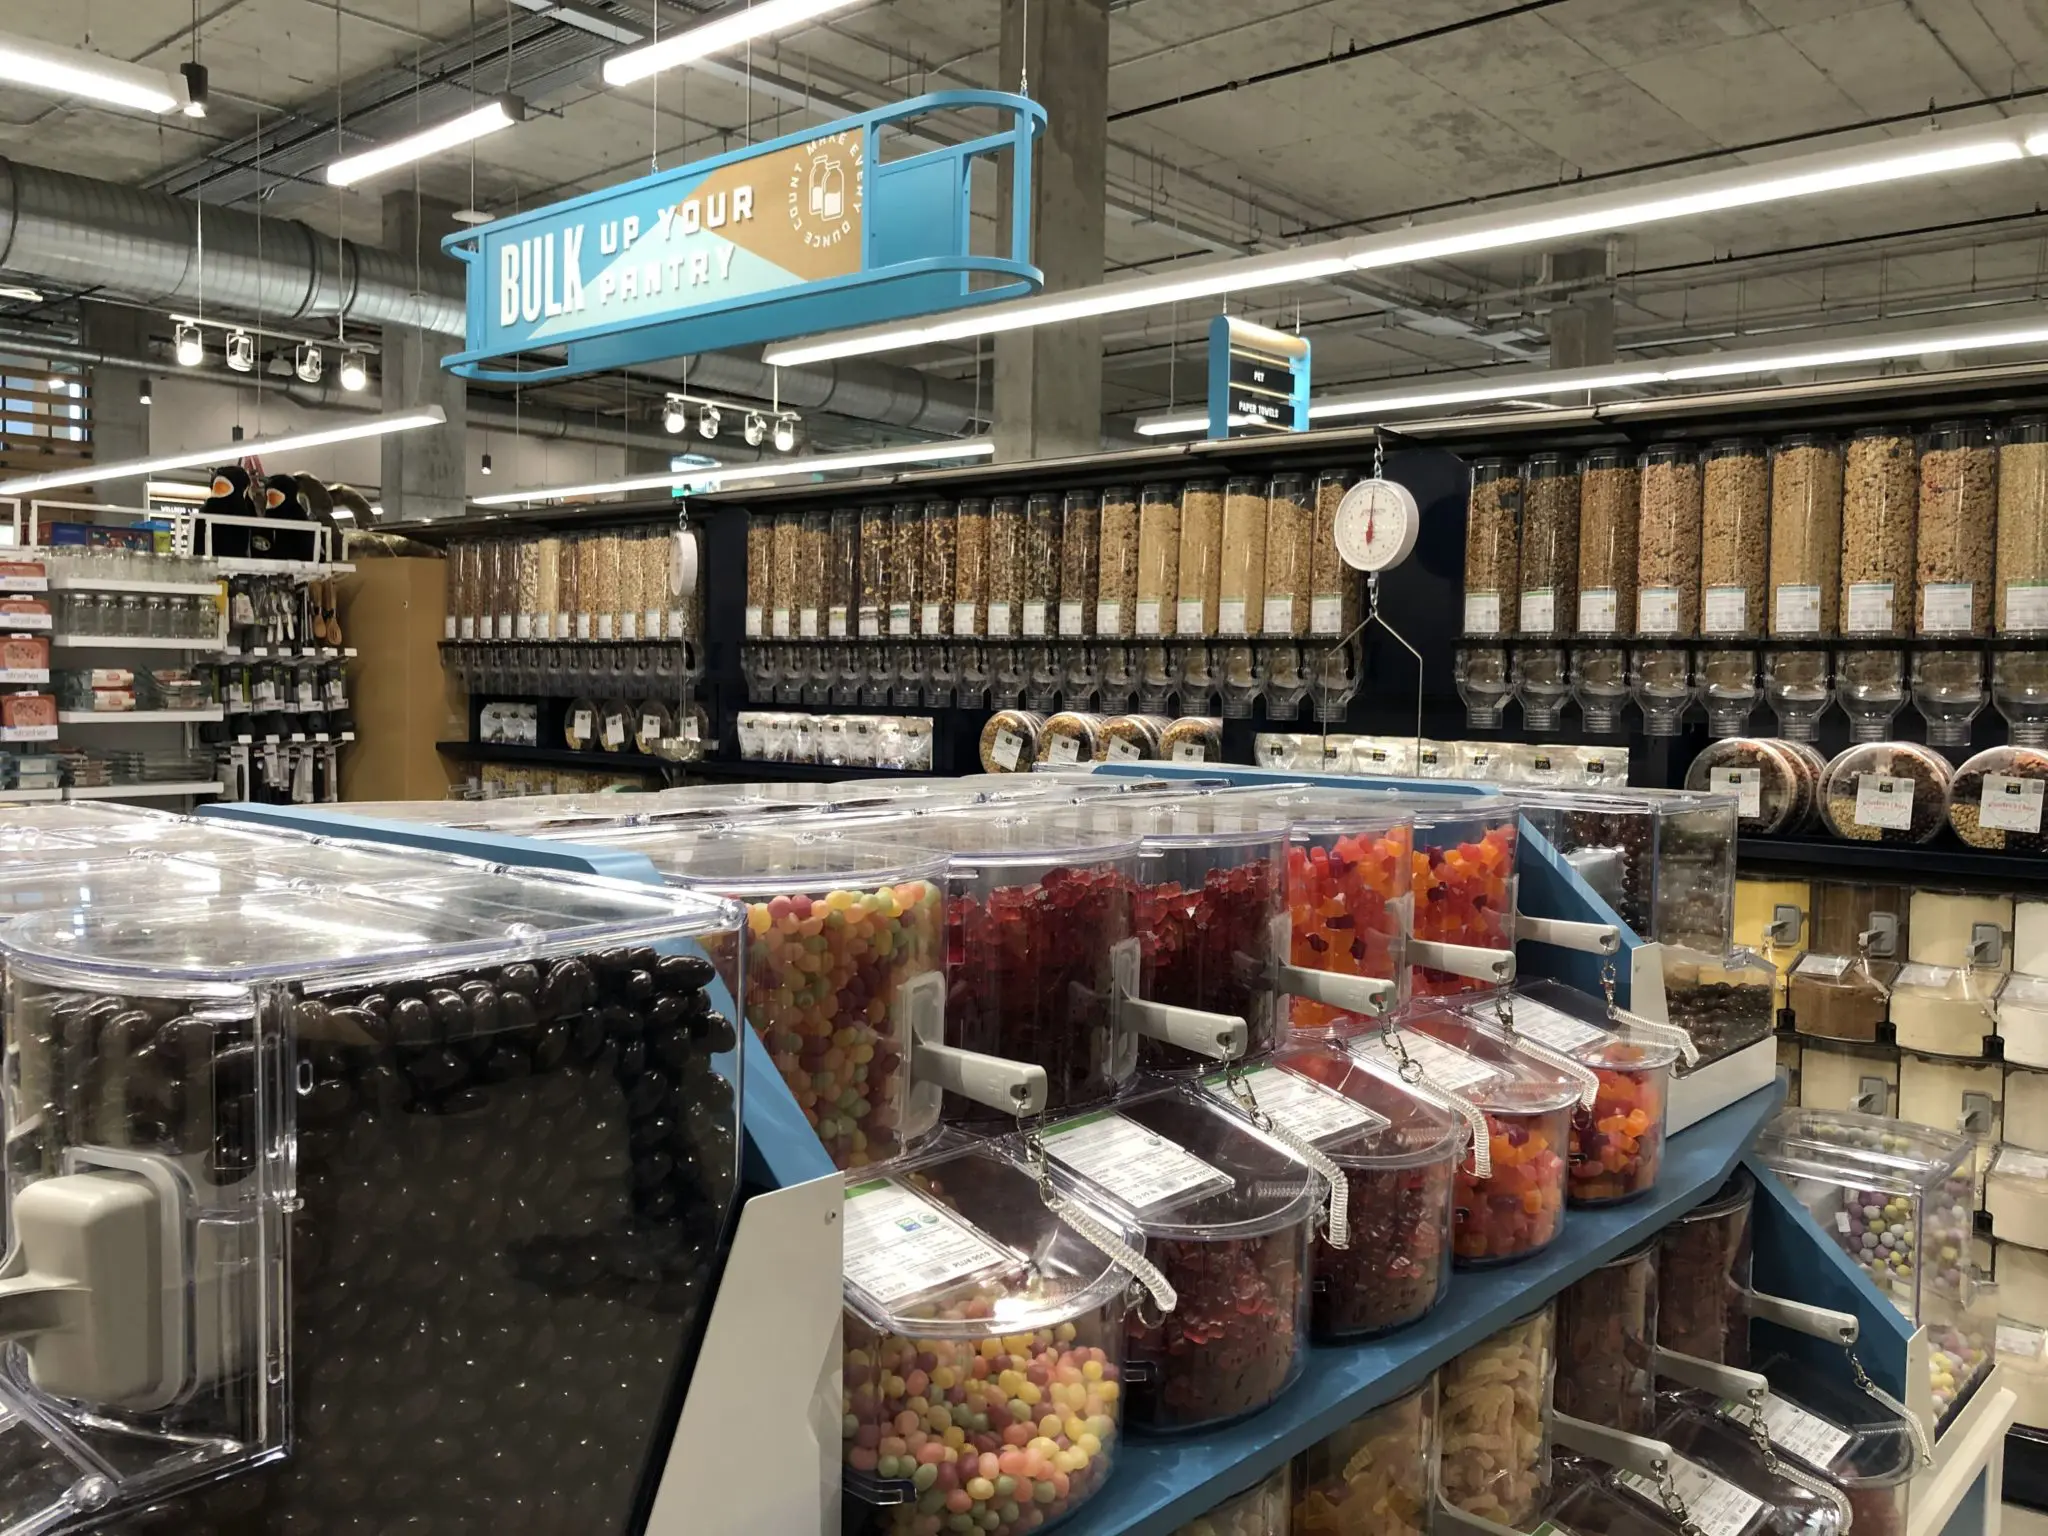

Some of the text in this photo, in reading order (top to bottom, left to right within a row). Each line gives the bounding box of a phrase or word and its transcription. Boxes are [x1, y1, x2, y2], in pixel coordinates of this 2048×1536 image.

[600, 185, 755, 255] UP YOUR
[788, 163, 803, 231] COUNT
[803, 219, 851, 247] OUNCE
[500, 223, 585, 328] BULK
[600, 242, 736, 306] PANTRY
[1253, 370, 1265, 383] PET
[1238, 400, 1279, 419] PAPER TOWELS
